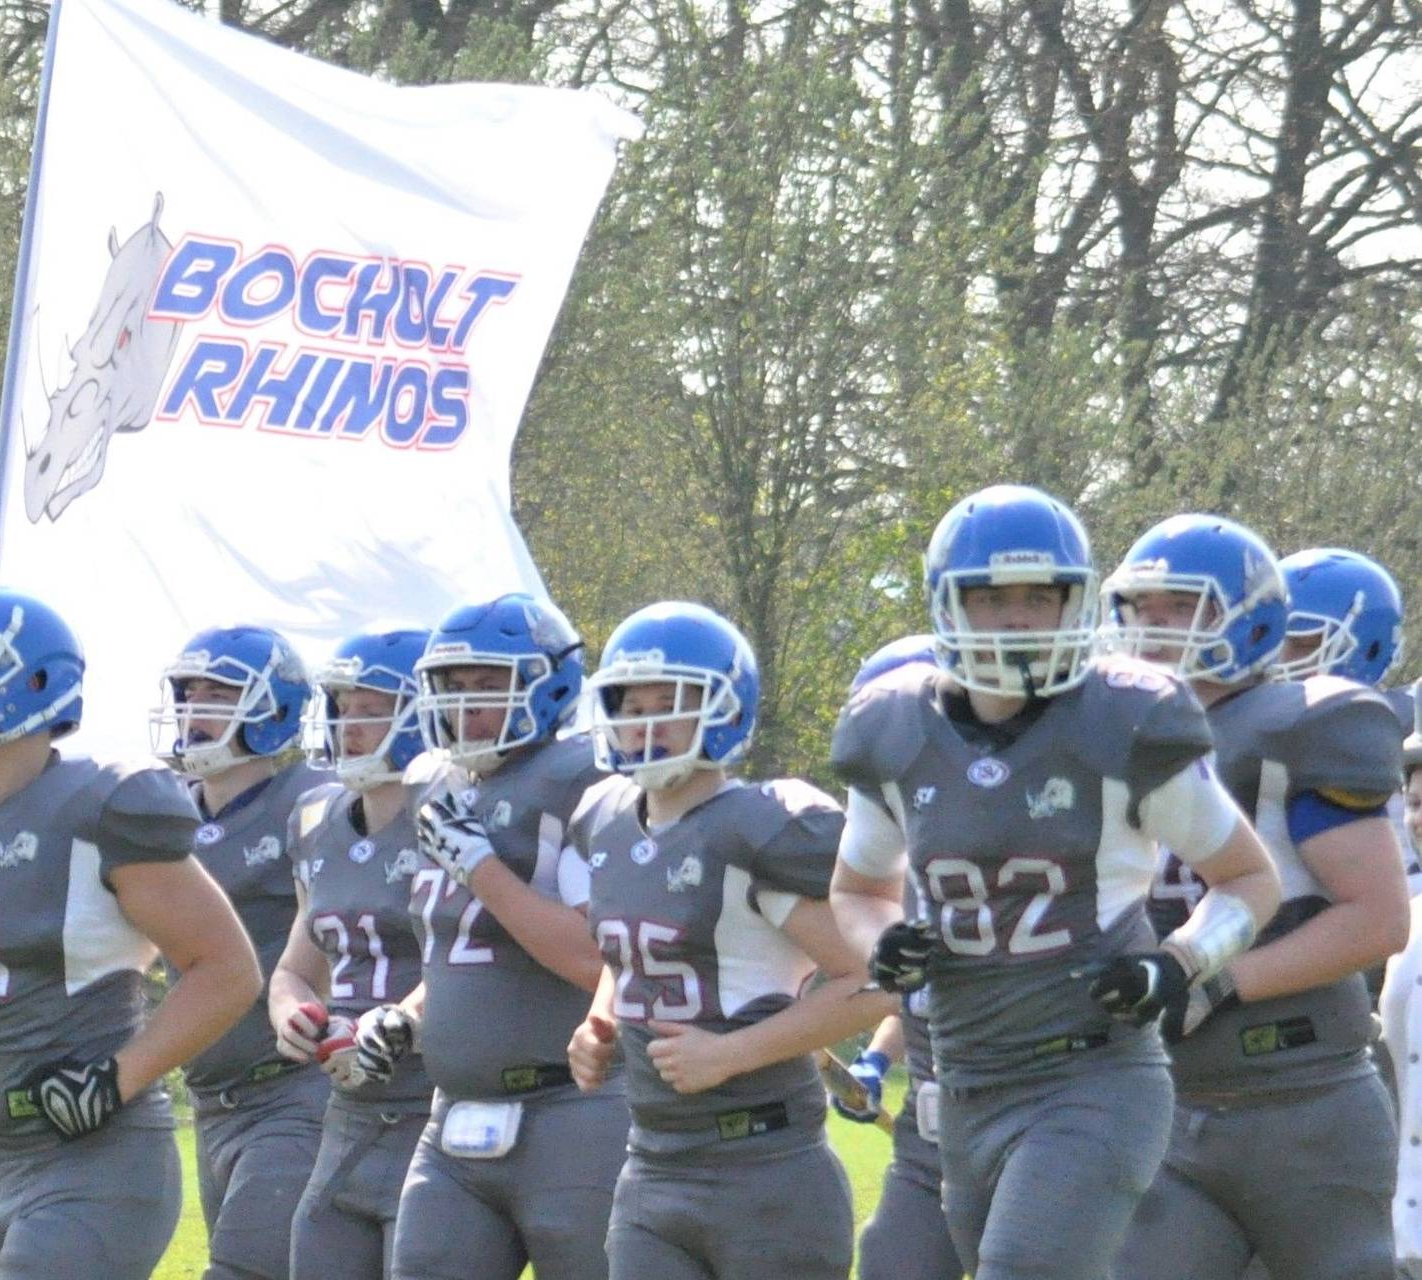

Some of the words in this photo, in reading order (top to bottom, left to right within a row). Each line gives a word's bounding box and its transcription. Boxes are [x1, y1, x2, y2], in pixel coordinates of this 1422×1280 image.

[149, 235, 520, 352] BOCHOLT
[158, 337, 471, 450] RHINOS
[313, 914, 390, 1000] 21
[414, 868, 495, 965] 72
[924, 857, 1073, 956] 82
[596, 918, 703, 1021] 25
